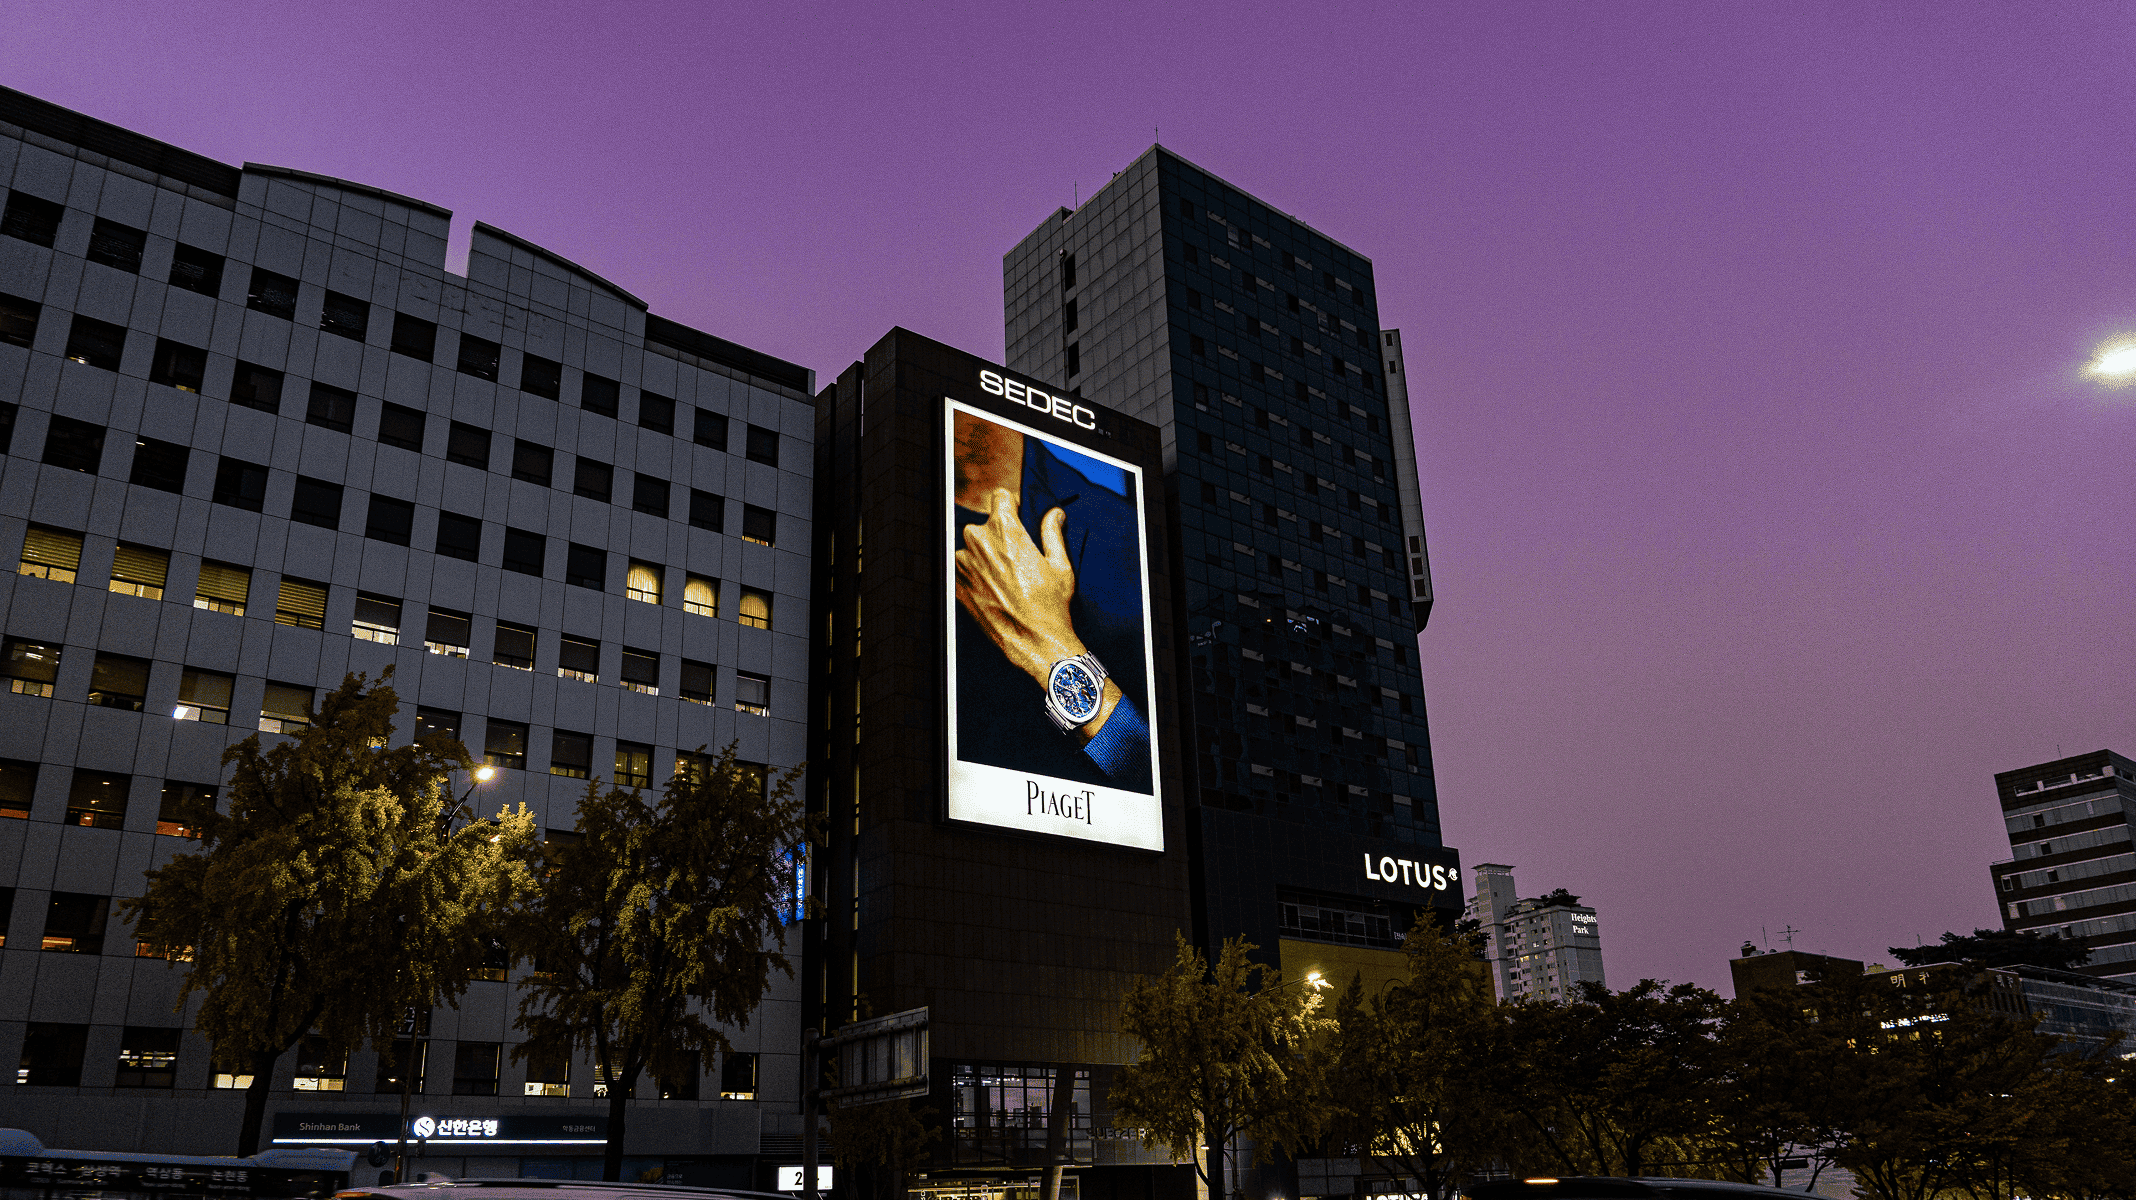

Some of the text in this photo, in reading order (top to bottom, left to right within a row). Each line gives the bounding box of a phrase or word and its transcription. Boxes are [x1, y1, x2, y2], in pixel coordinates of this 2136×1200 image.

[980, 369, 1096, 431] SEDEC
[1026, 780, 1095, 825] PIAGET
[1364, 852, 1448, 891] LOTUS
[1571, 912, 1597, 924] Heights
[1573, 925, 1589, 934] Park
[299, 1122, 361, 1131] Shinhan Bank
[437, 1119, 498, 1136] 신한은행
